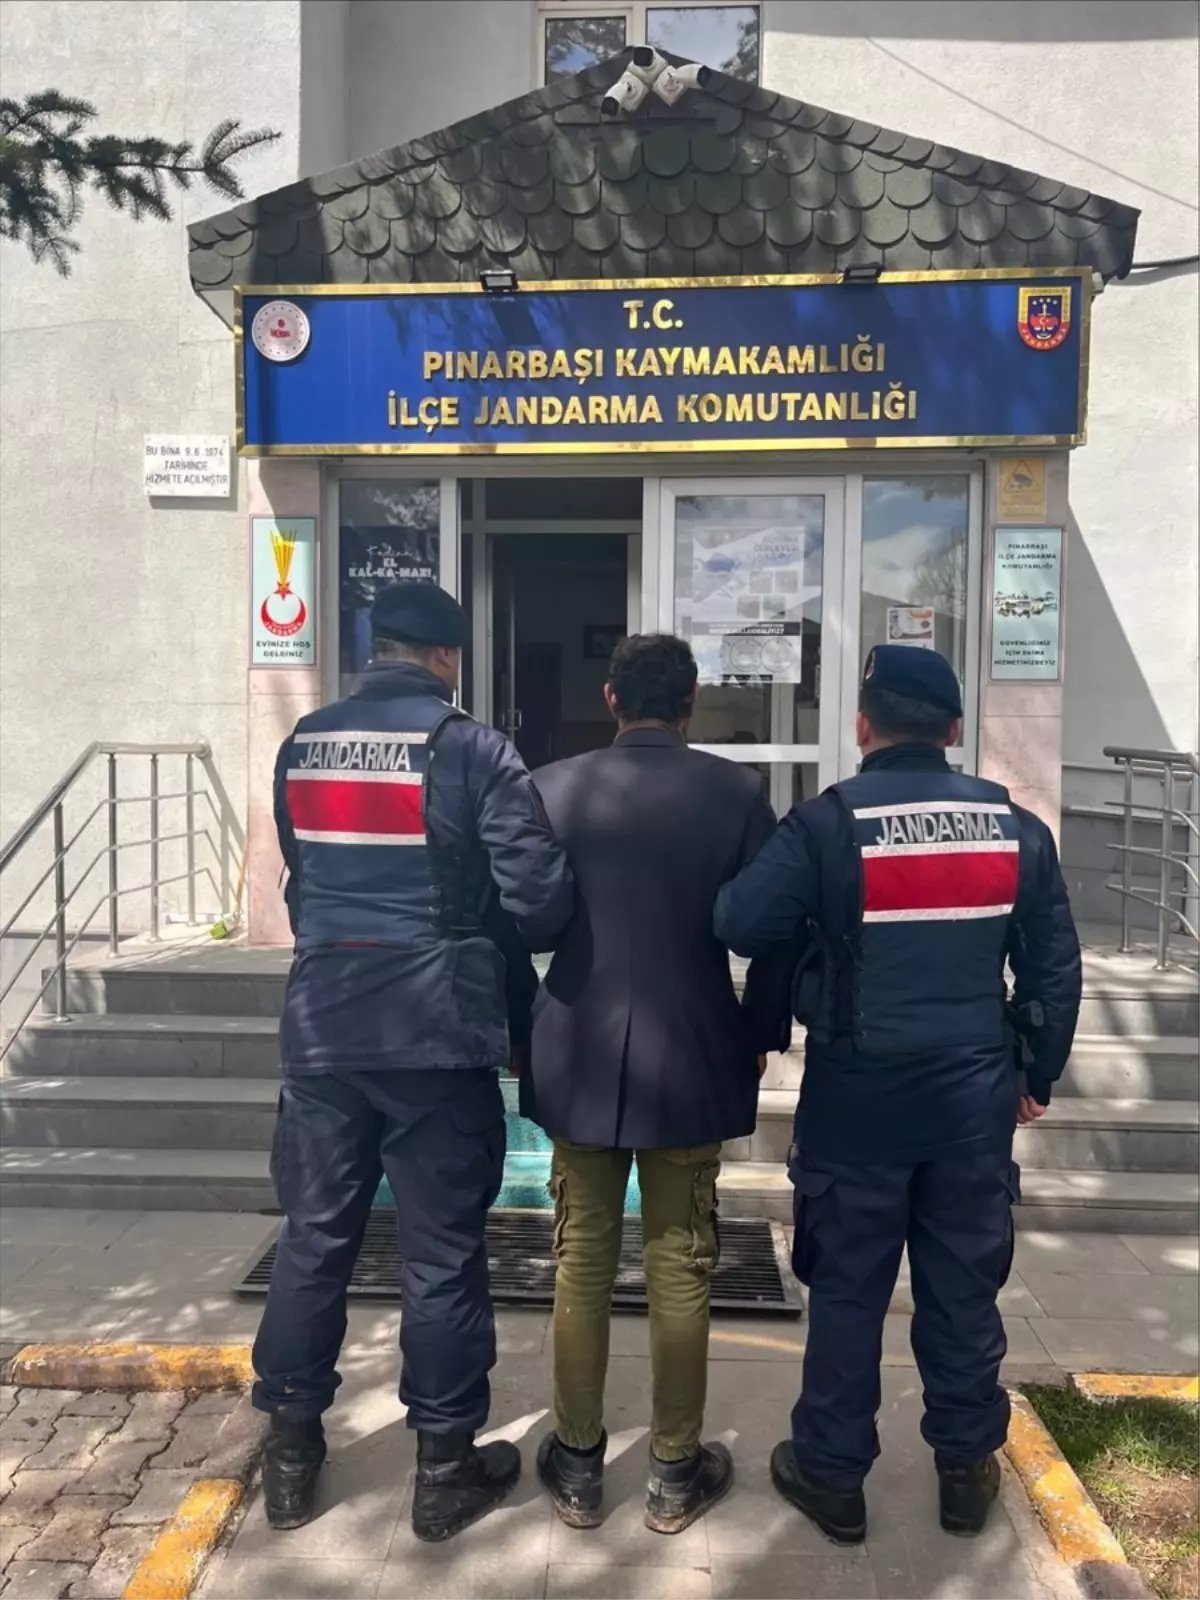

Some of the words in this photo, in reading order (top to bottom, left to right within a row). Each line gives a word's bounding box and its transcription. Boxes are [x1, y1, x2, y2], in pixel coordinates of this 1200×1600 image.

[623, 299, 684, 330] T.C.
[423, 348, 604, 385] PINARBAŞI
[615, 334, 885, 378] KAYMAKAMLIĞI
[387, 390, 460, 433] İLÇE
[474, 394, 664, 425] JANDARMA
[677, 381, 917, 424] KOMUTANLIĞI
[145, 446, 158, 456] BU
[292, 640, 311, 649] HOŞ
[300, 741, 411, 771] JANDARMA
[876, 811, 1005, 846] JANDARMA
